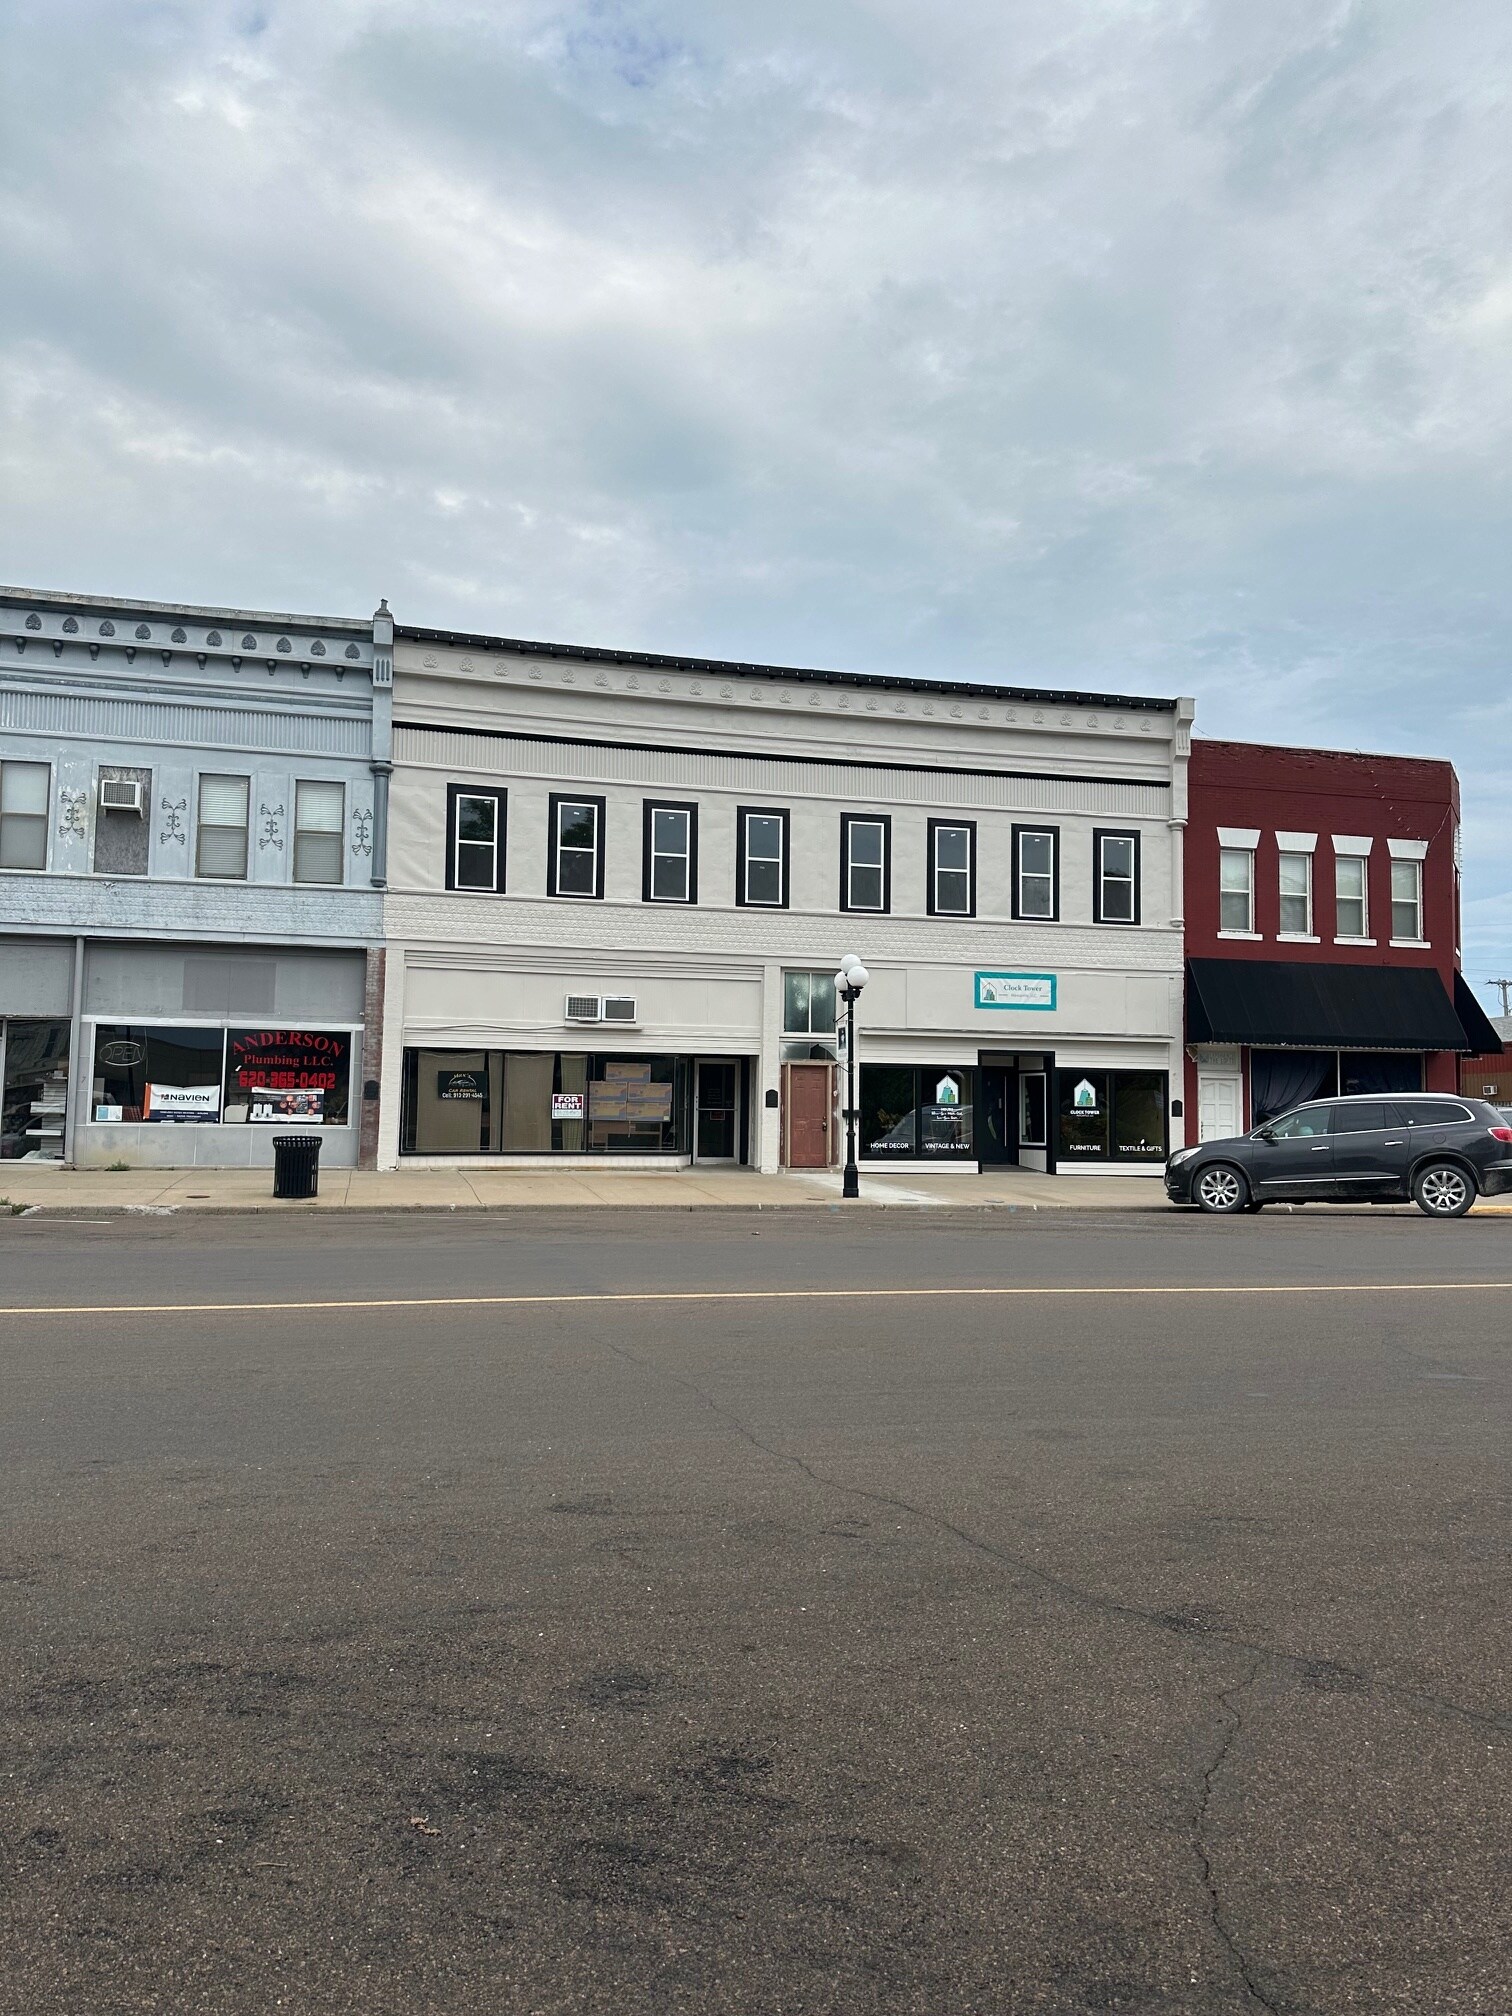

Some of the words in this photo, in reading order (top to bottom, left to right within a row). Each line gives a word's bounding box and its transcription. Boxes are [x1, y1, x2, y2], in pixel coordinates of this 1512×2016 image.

[1023, 984, 1043, 992] Tower
[233, 1031, 344, 1057] ANDERSON
[99, 1045, 145, 1061] OPEN
[244, 1055, 300, 1067] Plumbing
[303, 1056, 334, 1066] LLC.
[239, 1071, 336, 1089] 620-365-0402
